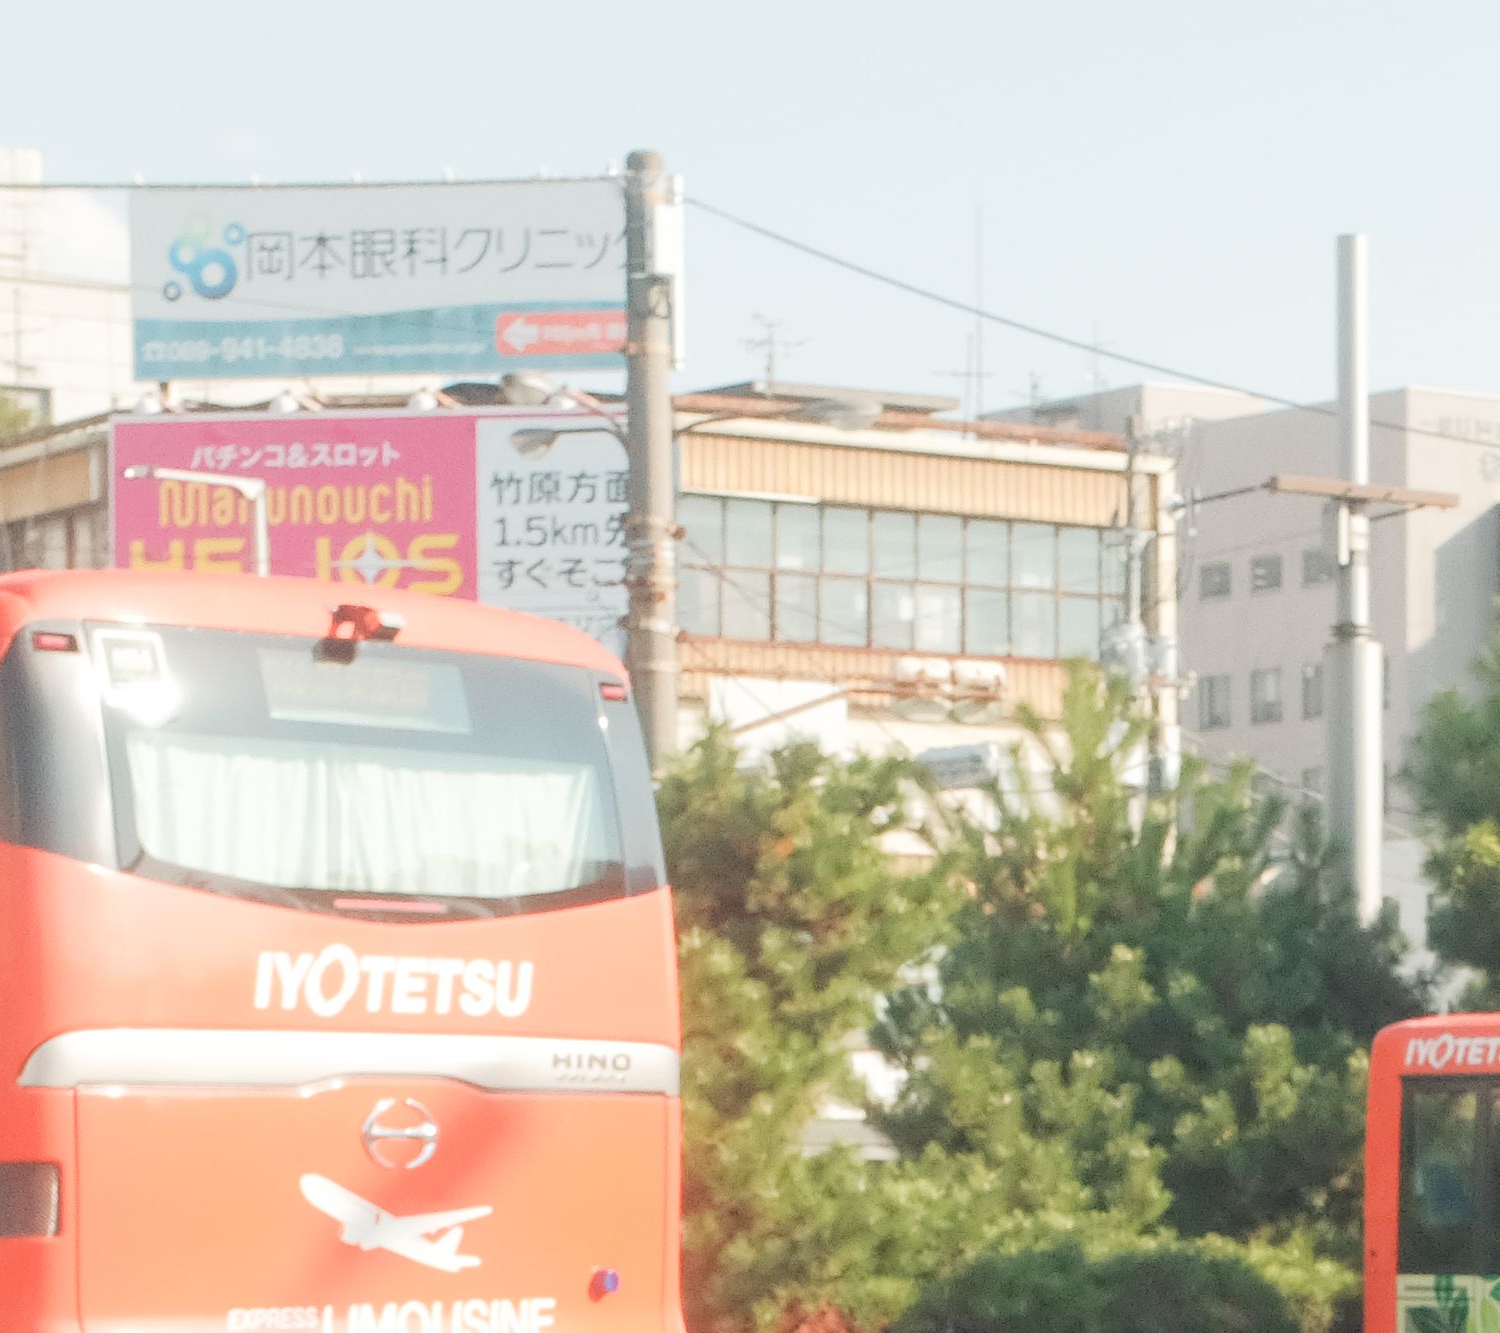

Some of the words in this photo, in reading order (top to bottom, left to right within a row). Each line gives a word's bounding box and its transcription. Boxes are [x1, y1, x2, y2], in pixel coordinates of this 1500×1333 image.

[191, 441, 400, 470] パチンコ&スロット
[130, 533, 463, 596] HEIOS
[253, 944, 533, 1017] IYOTETSU
[553, 1053, 631, 1071] HINO
[227, 1307, 317, 1332] EXPRESS
